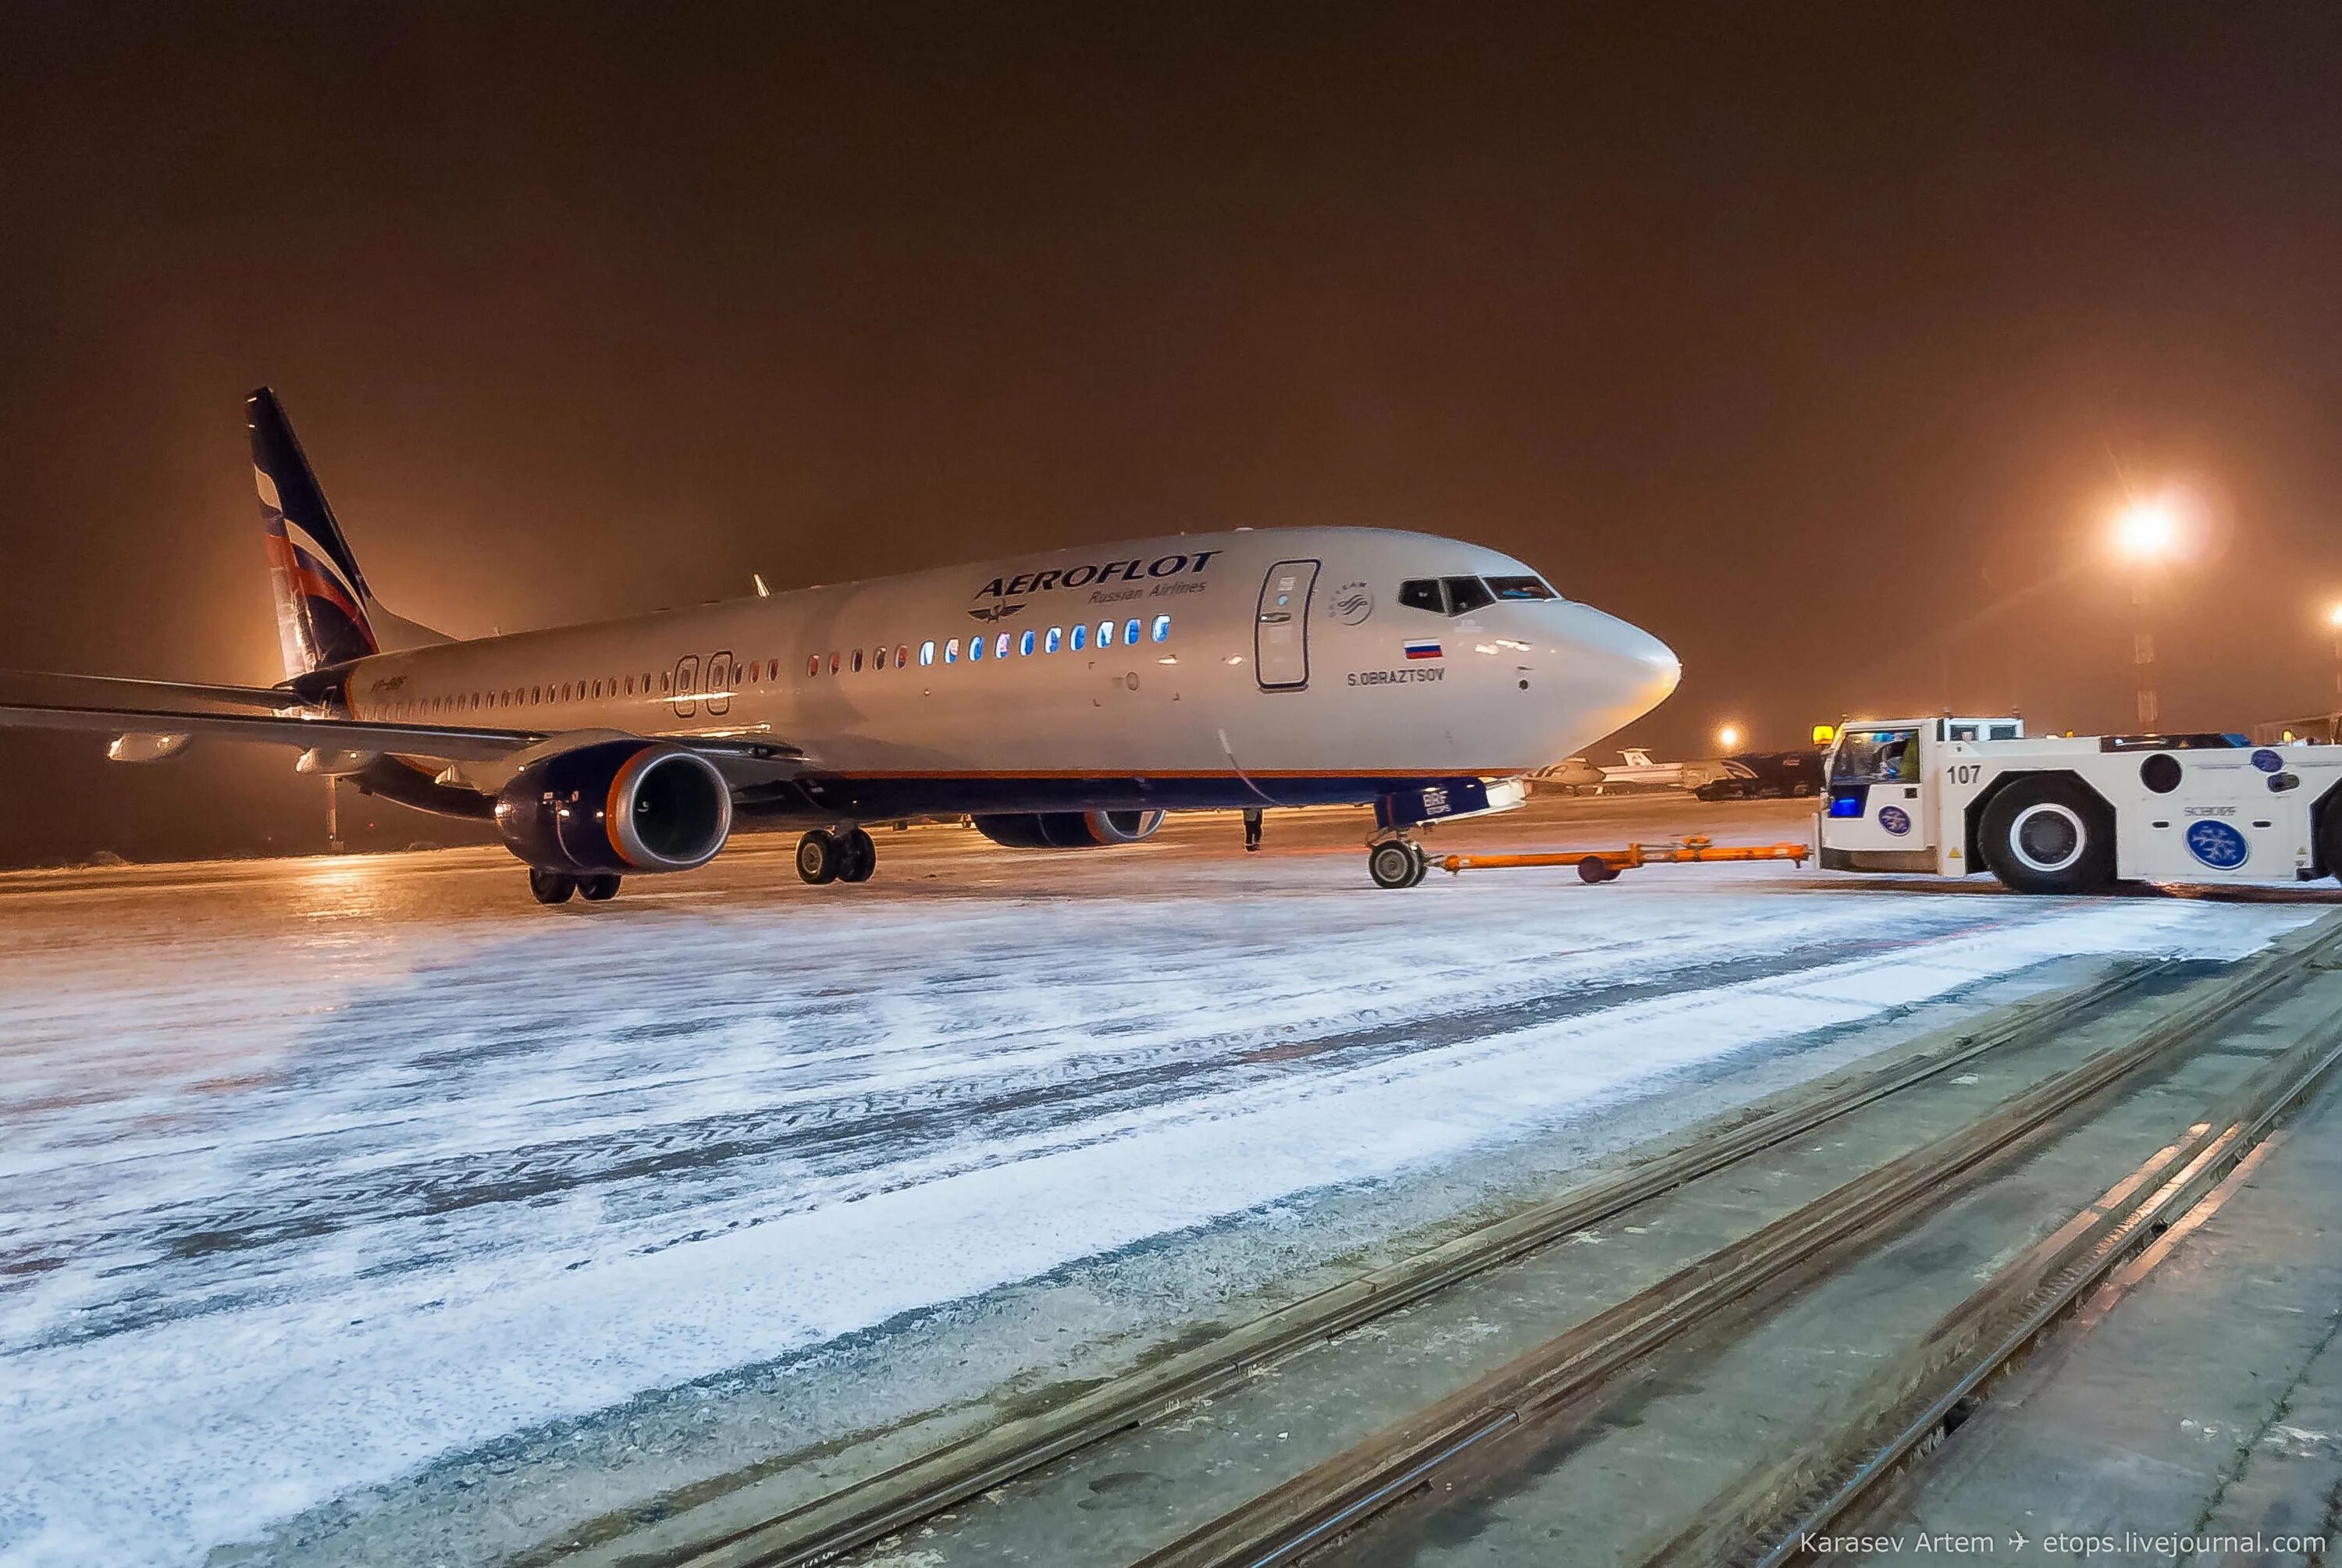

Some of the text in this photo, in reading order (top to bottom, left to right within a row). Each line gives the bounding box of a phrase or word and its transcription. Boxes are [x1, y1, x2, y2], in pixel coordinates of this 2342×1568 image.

[973, 549, 1223, 600] AEROFLOT
[1088, 581, 1208, 606] Russian Airlines
[1947, 765, 1981, 784] 107
